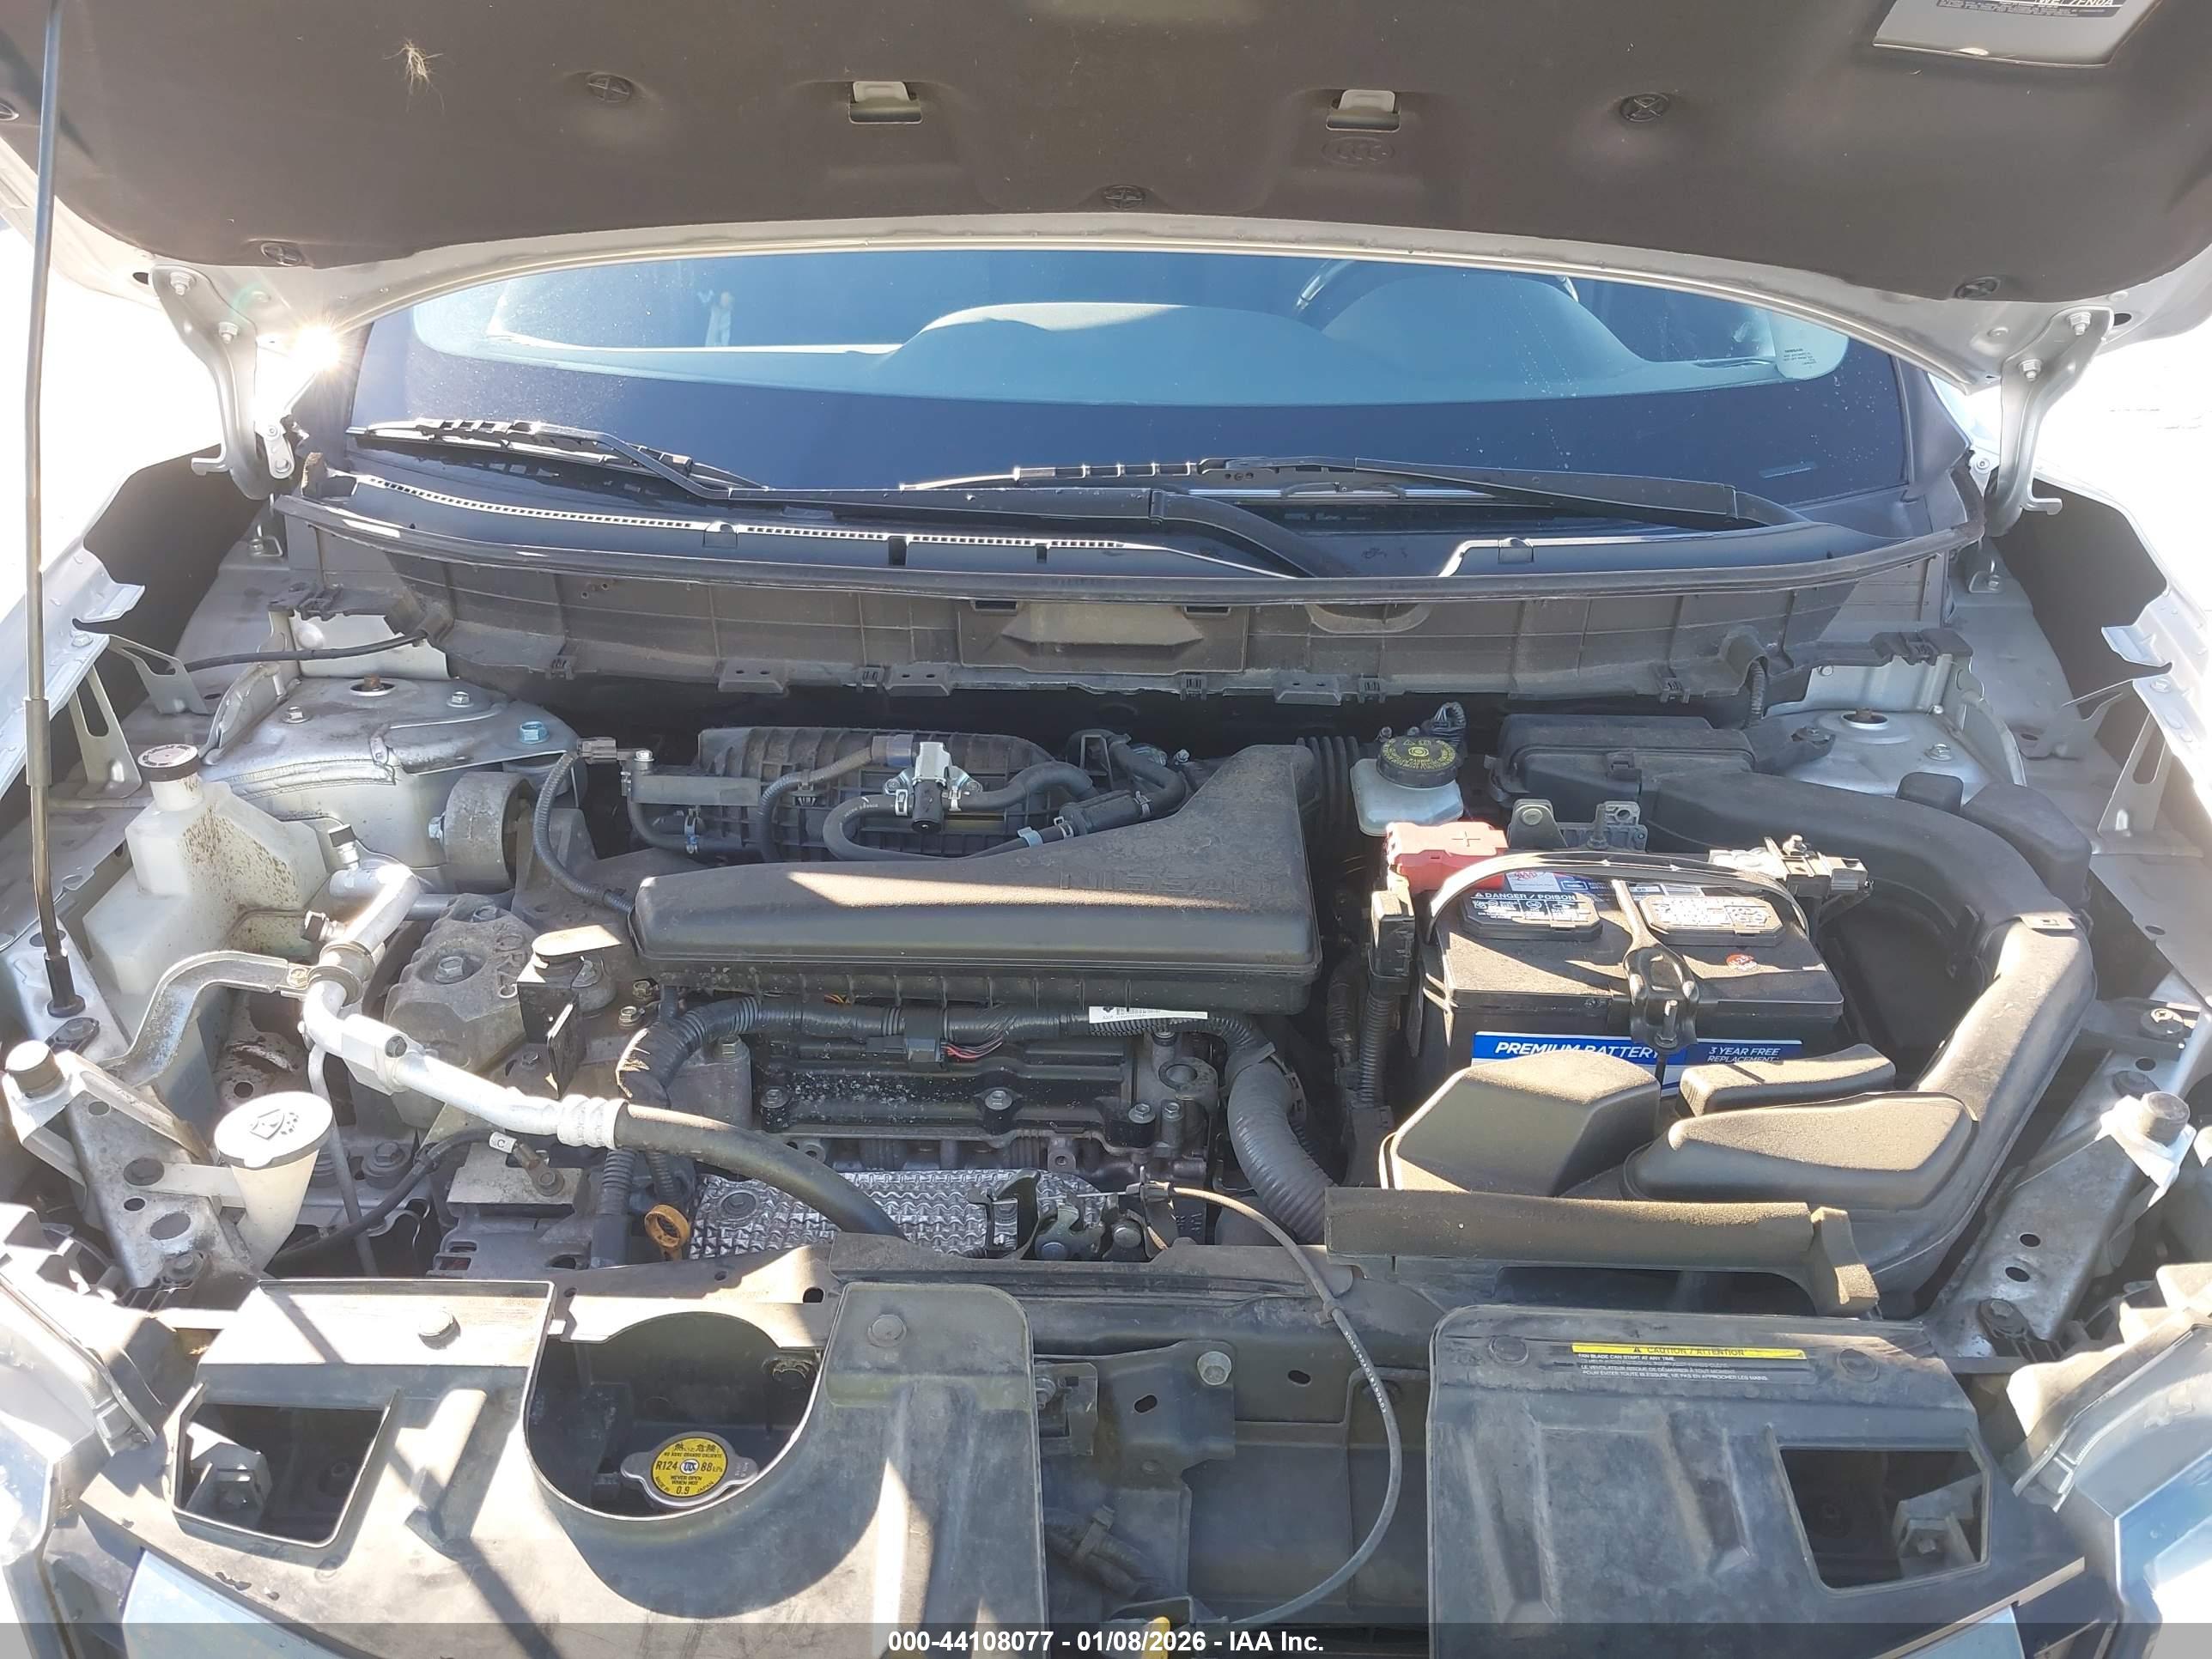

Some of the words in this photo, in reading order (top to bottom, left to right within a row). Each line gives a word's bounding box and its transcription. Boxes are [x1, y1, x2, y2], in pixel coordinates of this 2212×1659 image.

[1718, 1047, 1748, 1055] YEAR
[1750, 1048, 1781, 1056] FREE
[497, 1139, 506, 1148] C
[655, 1461, 678, 1471] R124
[676, 1486, 690, 1495] 0.9
